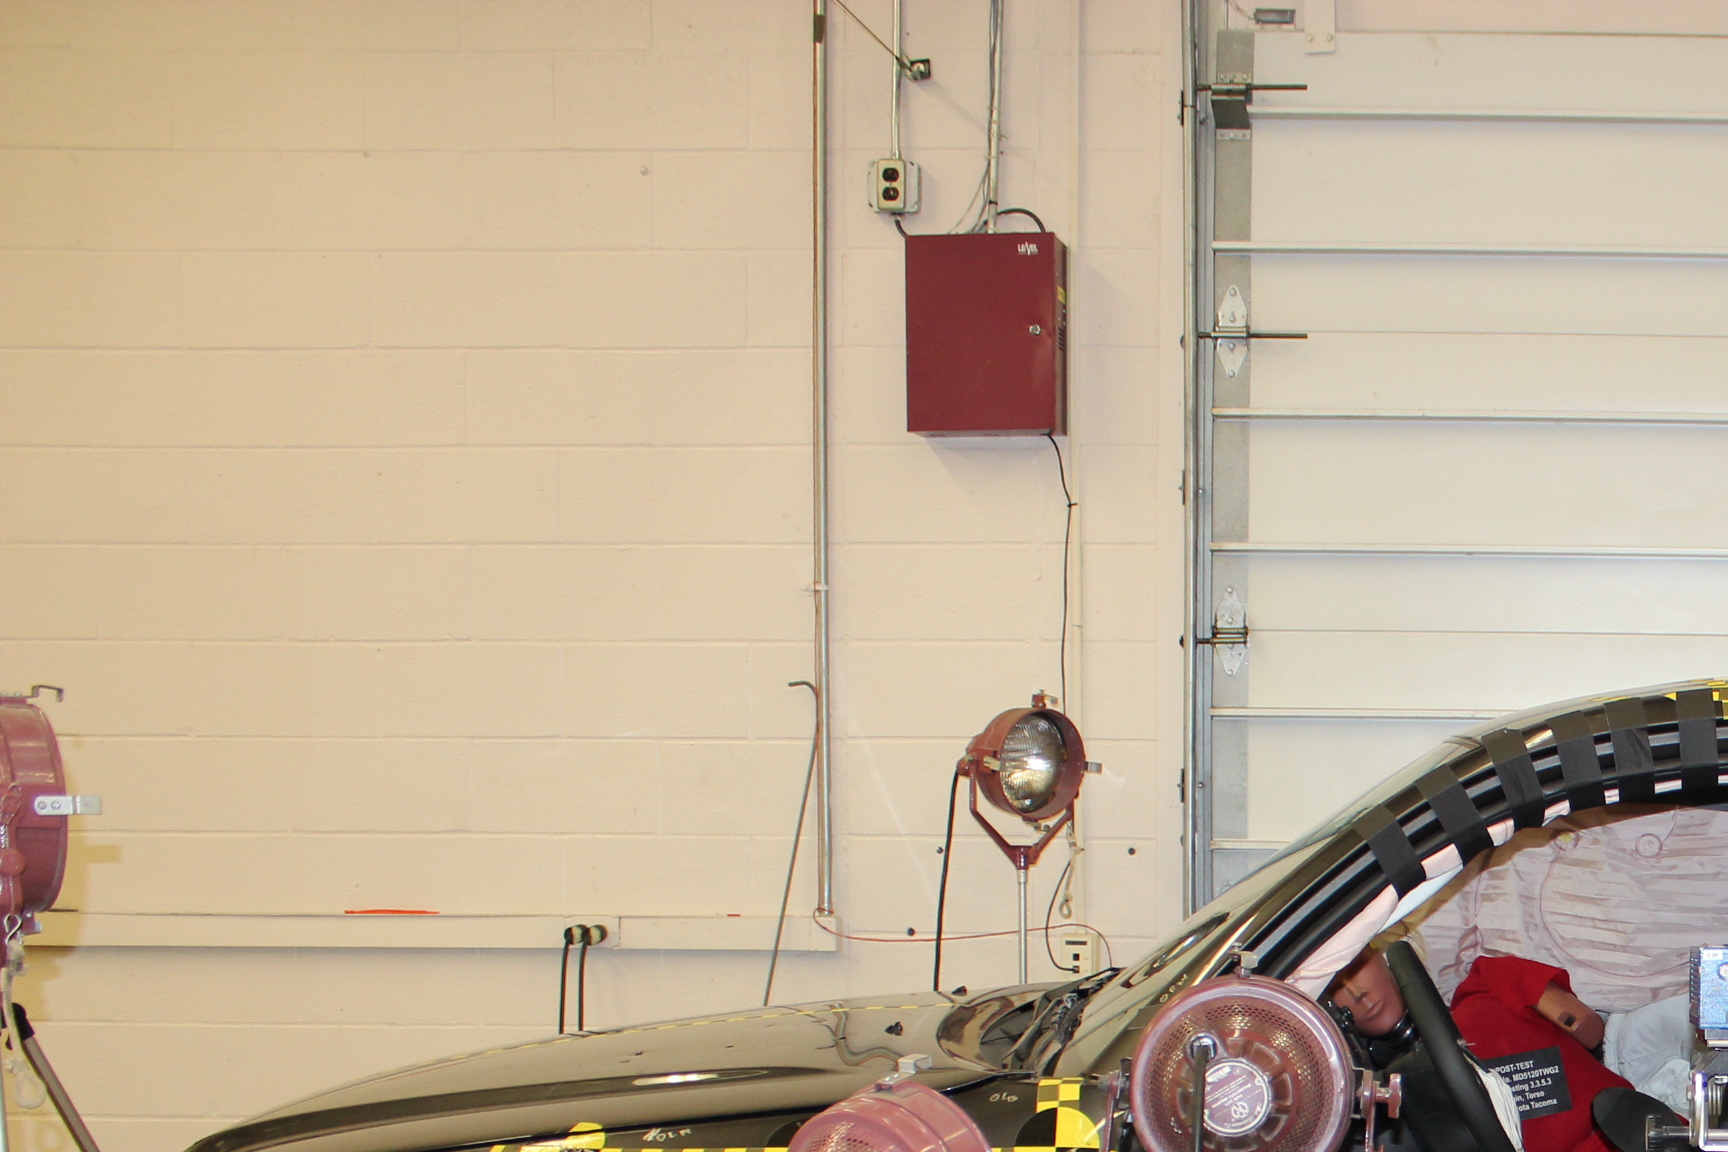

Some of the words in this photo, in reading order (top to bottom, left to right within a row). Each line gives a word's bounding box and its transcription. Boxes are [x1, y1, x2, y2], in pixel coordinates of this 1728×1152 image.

[1512, 1066, 1559, 1082] MD5120TWG2
[1511, 1081, 1529, 1092] sting
[1530, 1078, 1552, 1089] 3.3.5.3
[1525, 1091, 1545, 1100] Torso
[1530, 1098, 1558, 1110] Tacoma
